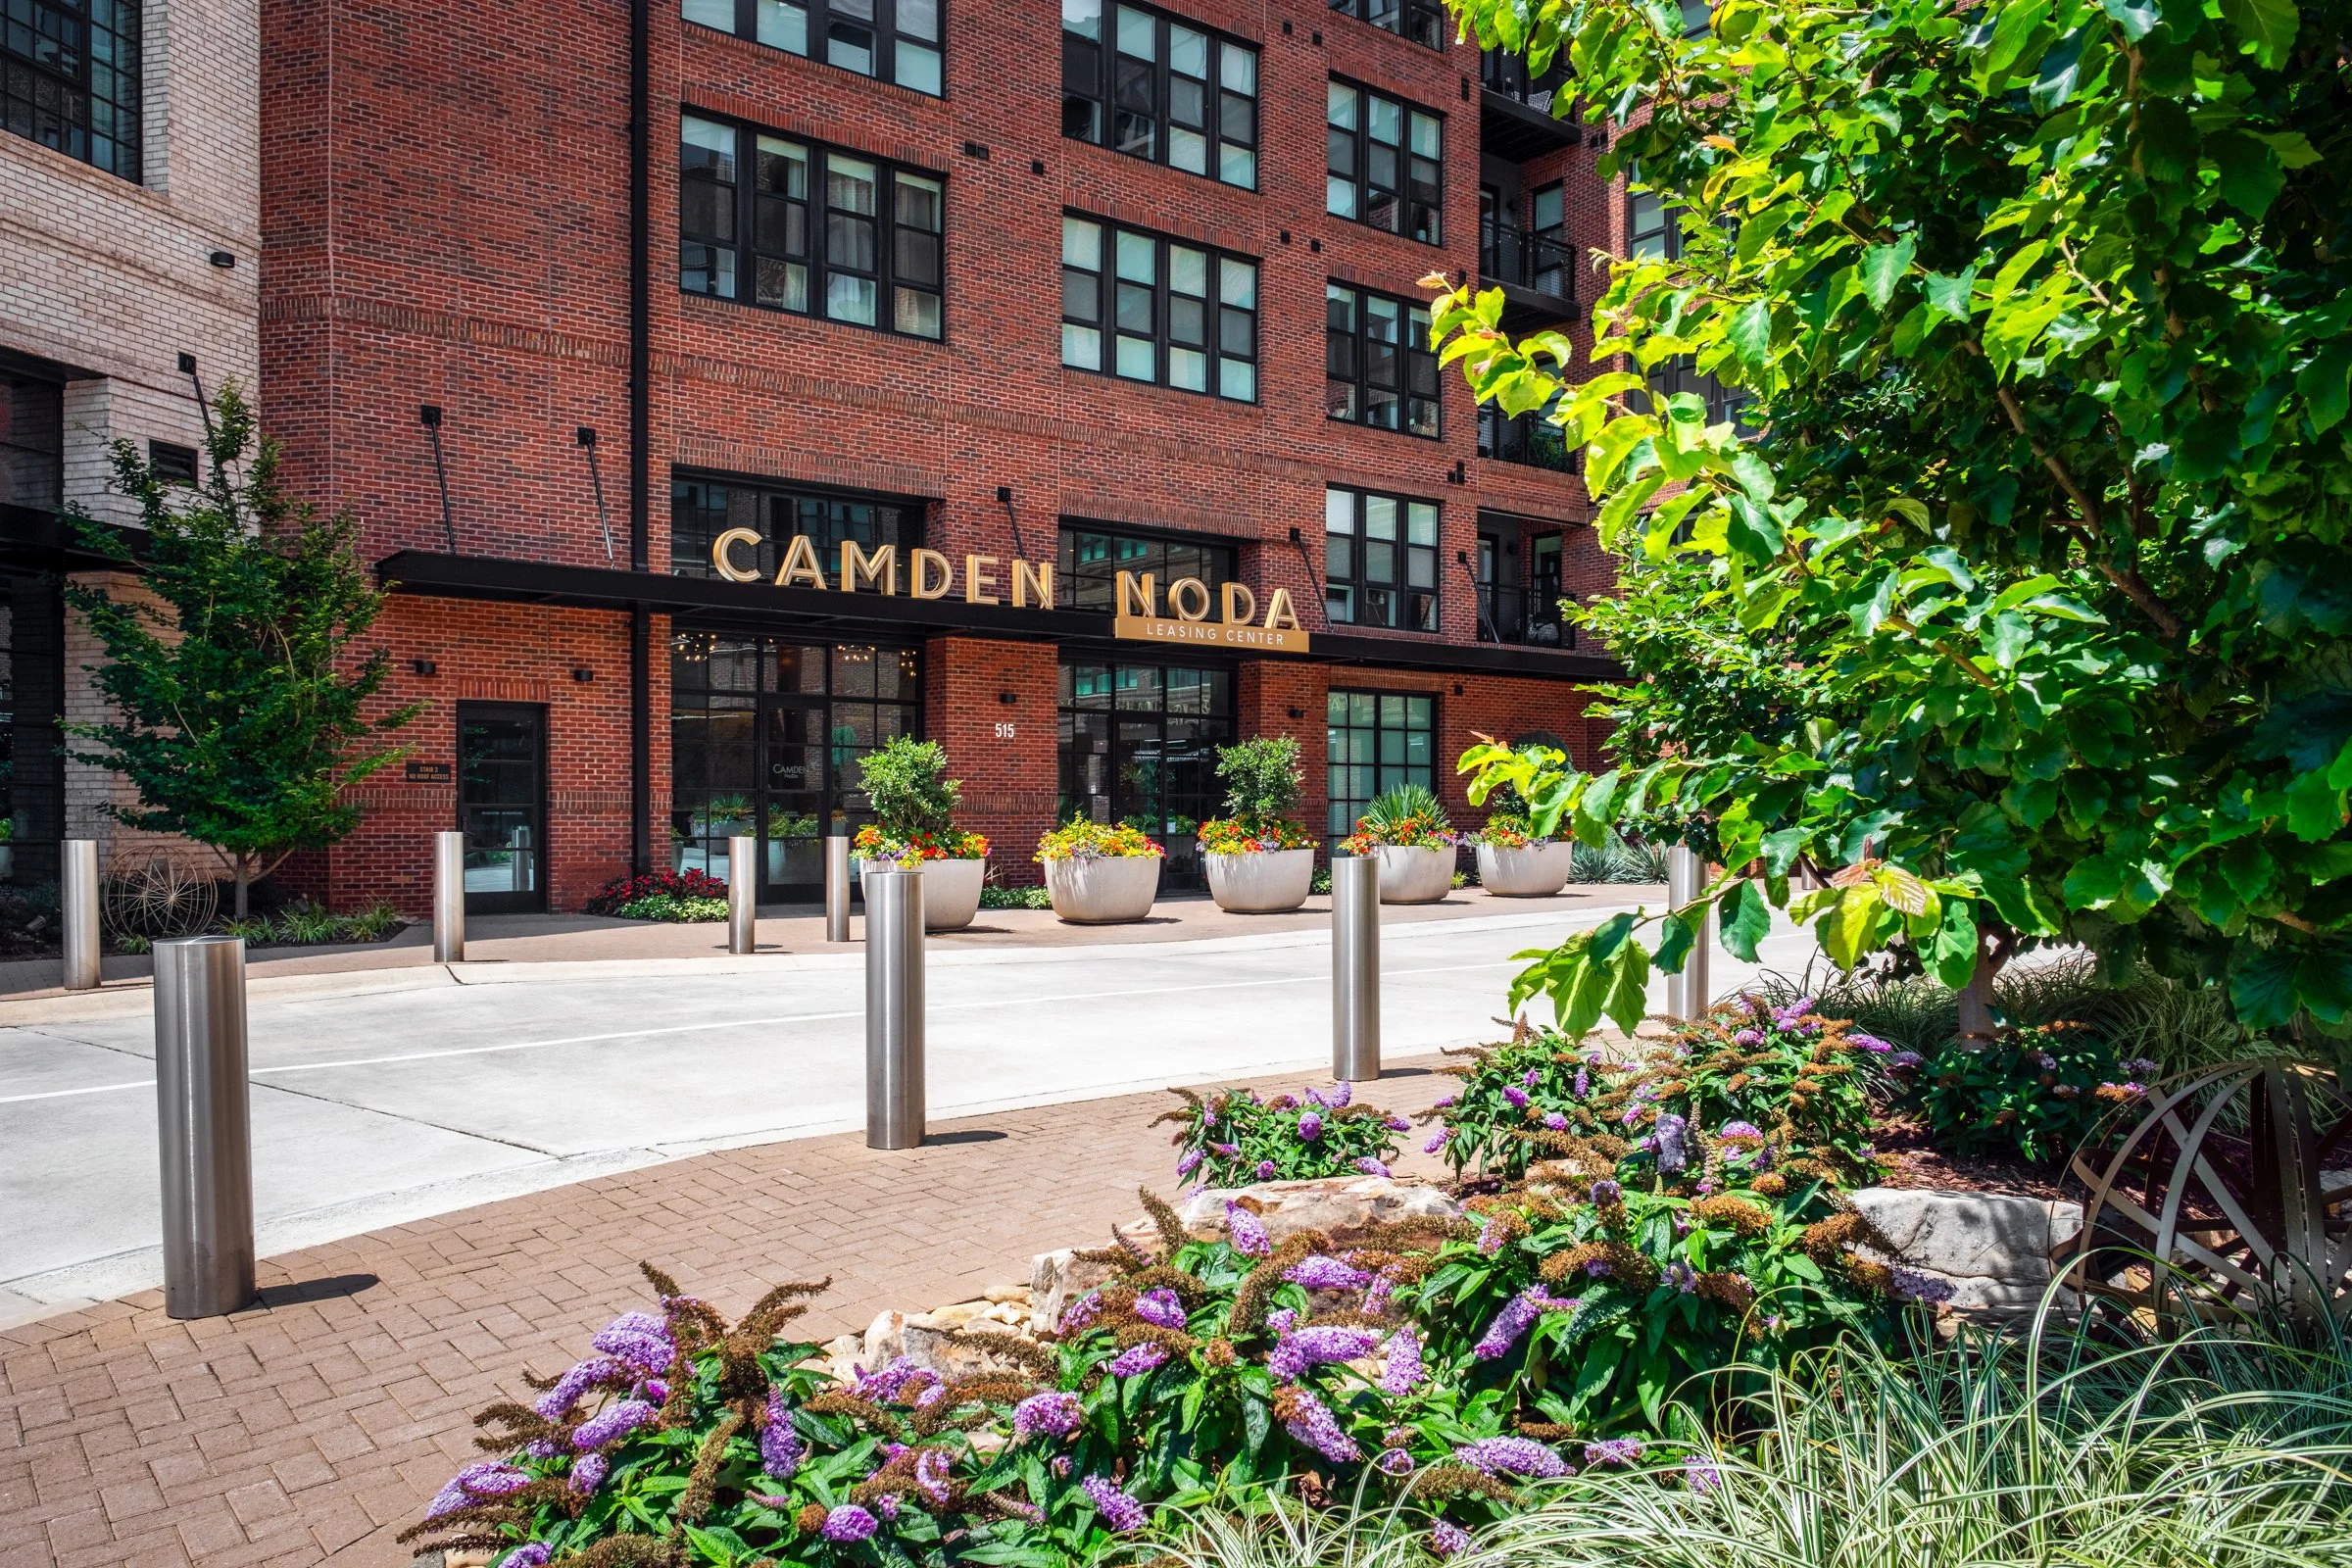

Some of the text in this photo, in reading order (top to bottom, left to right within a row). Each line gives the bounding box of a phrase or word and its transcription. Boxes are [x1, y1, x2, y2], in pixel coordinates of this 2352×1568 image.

[713, 527, 1301, 630] CAMDEN NODA
[1147, 622, 1284, 646] LEASING CENTER
[995, 722, 1014, 738] 515
